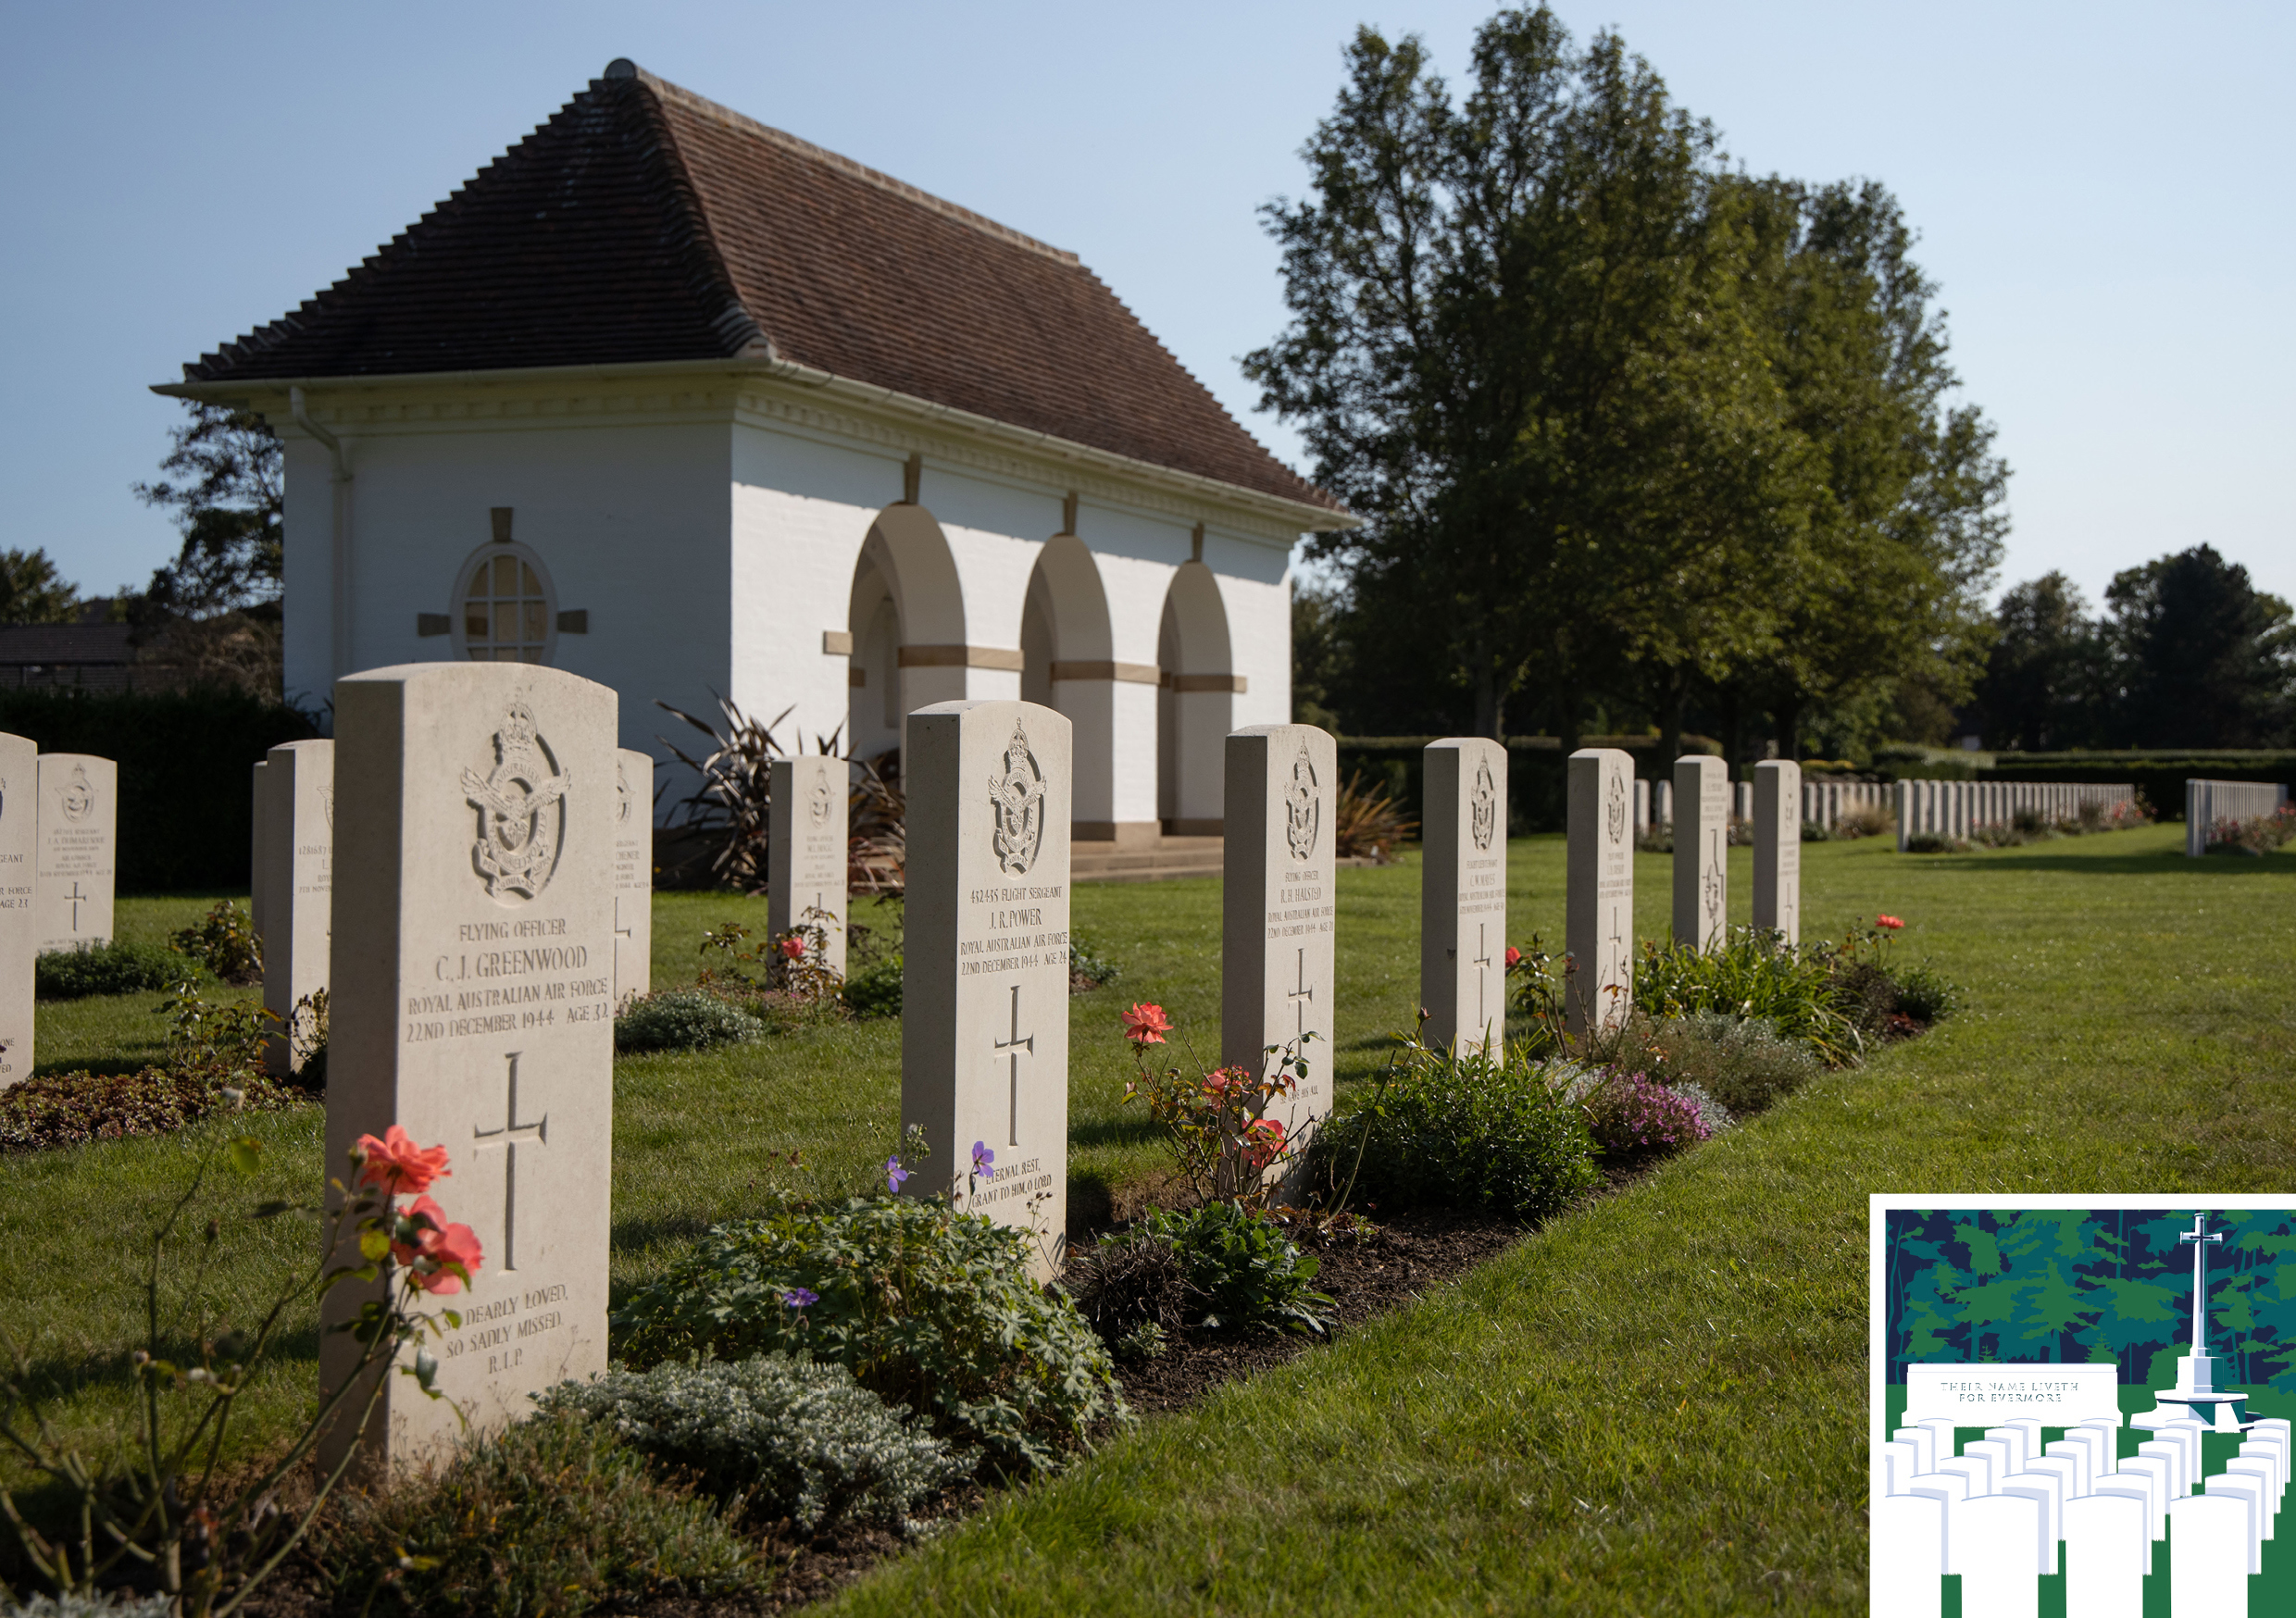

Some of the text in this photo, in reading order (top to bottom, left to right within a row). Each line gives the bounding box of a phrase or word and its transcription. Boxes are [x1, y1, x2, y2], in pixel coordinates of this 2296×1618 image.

[482, 857, 498, 874] PER
[8, 887, 32, 895] FORCE
[1002, 888, 1026, 902] FLIGHT
[1029, 886, 1062, 900] SERGEANT
[1280, 887, 1321, 903] R. H. HALSTED
[18, 899, 29, 908] 23
[1267, 912, 1282, 923] ROYAL
[1284, 908, 1311, 921] AUSTRALIAN
[1321, 906, 1333, 916] FORCE
[460, 918, 566, 941] FLYING OFFICER
[989, 908, 1042, 929] J. R. POWER
[1267, 927, 1279, 939] 22ND
[1282, 924, 1304, 938] DECEMBER
[1305, 922, 1316, 934] 1944
[960, 931, 1067, 955] ROYAL AUSTRALIAN AIR FORCE
[436, 945, 588, 982] C. J. GREENWOOD
[961, 950, 1067, 976] 22ND DECEMBER 1944 AGE 24
[408, 977, 608, 1014] ROYAL AUSTRALIAN AIR FORCE
[406, 1002, 608, 1042] 22ND DECEMBER 1944 AGE 32
[972, 1189, 997, 1208] GRANT
[1000, 1186, 1009, 1201] TO
[1027, 1180, 1032, 1192] O
[1034, 1174, 1052, 1190] LORD
[466, 1296, 518, 1326] DEARLY
[446, 1338, 463, 1359] SO
[470, 1325, 512, 1351] SADLY
